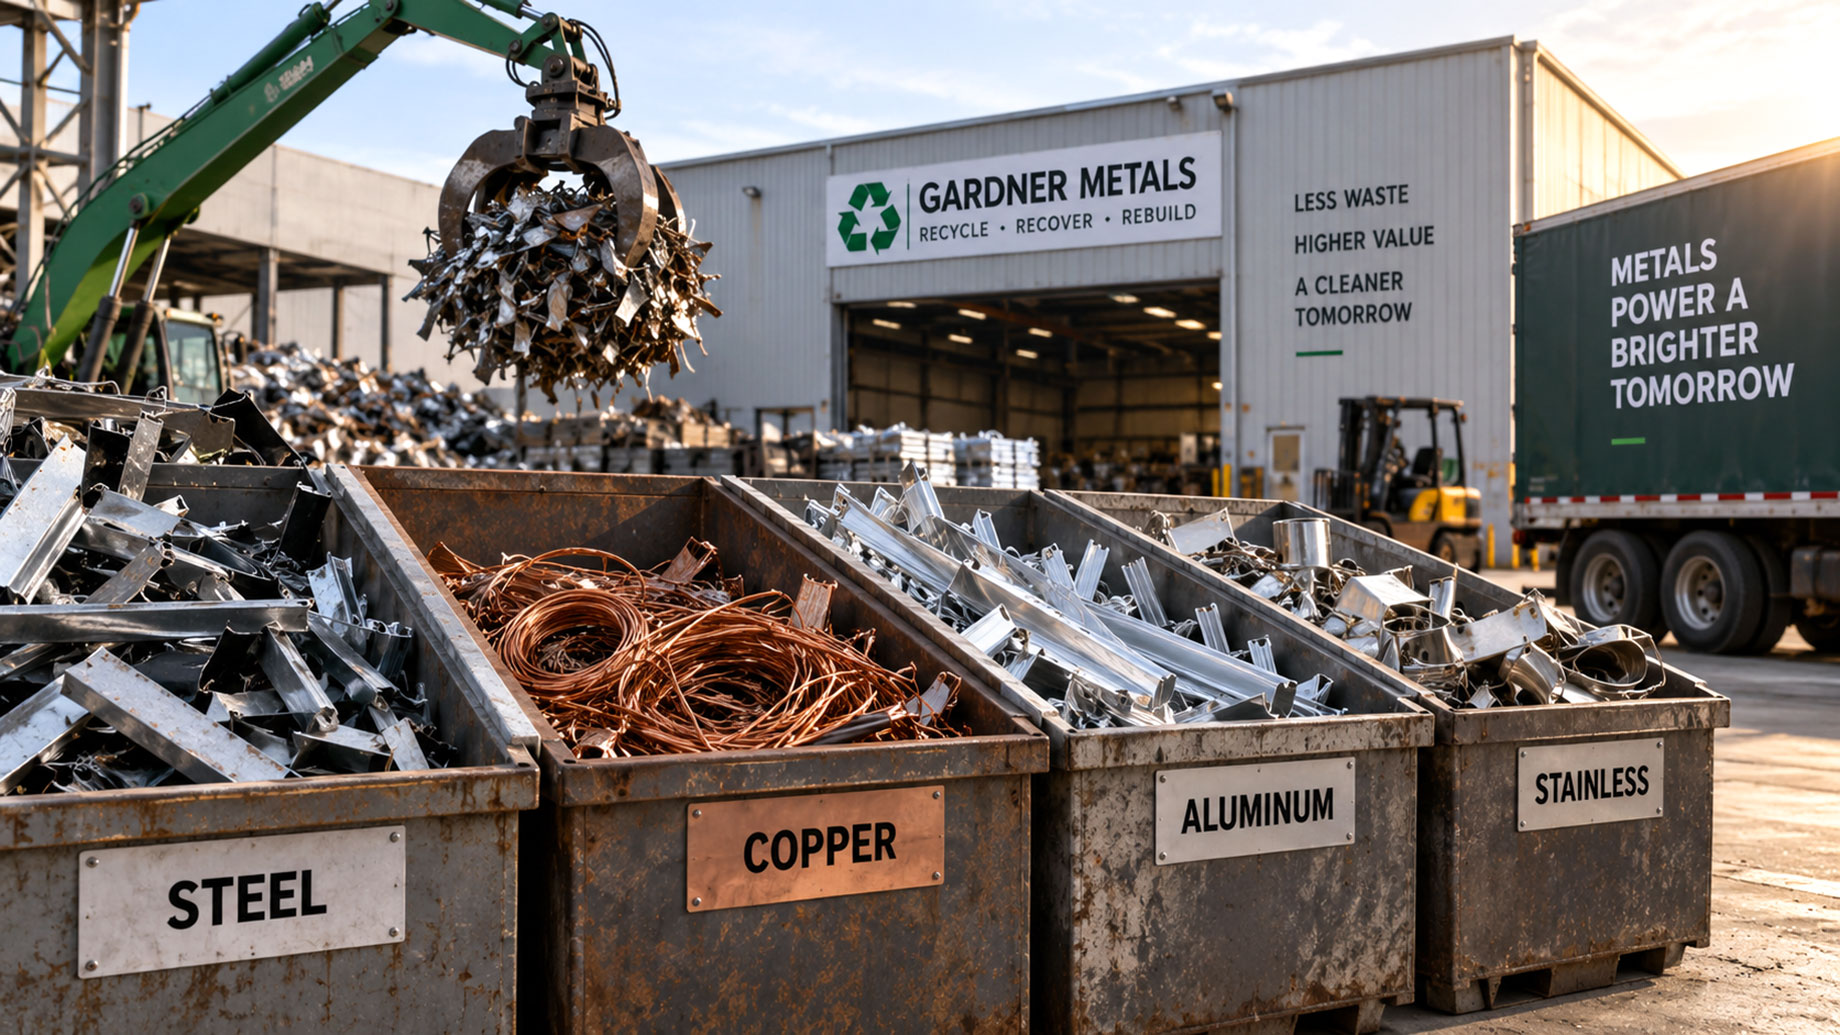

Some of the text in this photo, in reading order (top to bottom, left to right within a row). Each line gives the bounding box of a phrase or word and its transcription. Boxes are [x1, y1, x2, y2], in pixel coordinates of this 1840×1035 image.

[920, 156, 1196, 213] GARDNER METALS
[1294, 184, 1409, 213] LESS WASTE
[919, 203, 1196, 243] RECYCLE RECOVER REBUILD
[1294, 225, 1435, 254] HIGHER VALUE
[1295, 271, 1404, 296] A CLEANER
[1611, 237, 1718, 287] METALS
[1295, 302, 1413, 327] TOMORROW
[1611, 277, 1749, 328] POWER A
[1611, 320, 1760, 369] BRIGHTER
[1611, 362, 1795, 409] TOMORROW
[1535, 764, 1650, 805] STAINLESS
[1181, 786, 1334, 834] ALUMINUM
[744, 821, 897, 873] COPPER
[167, 869, 328, 930] STEEL
